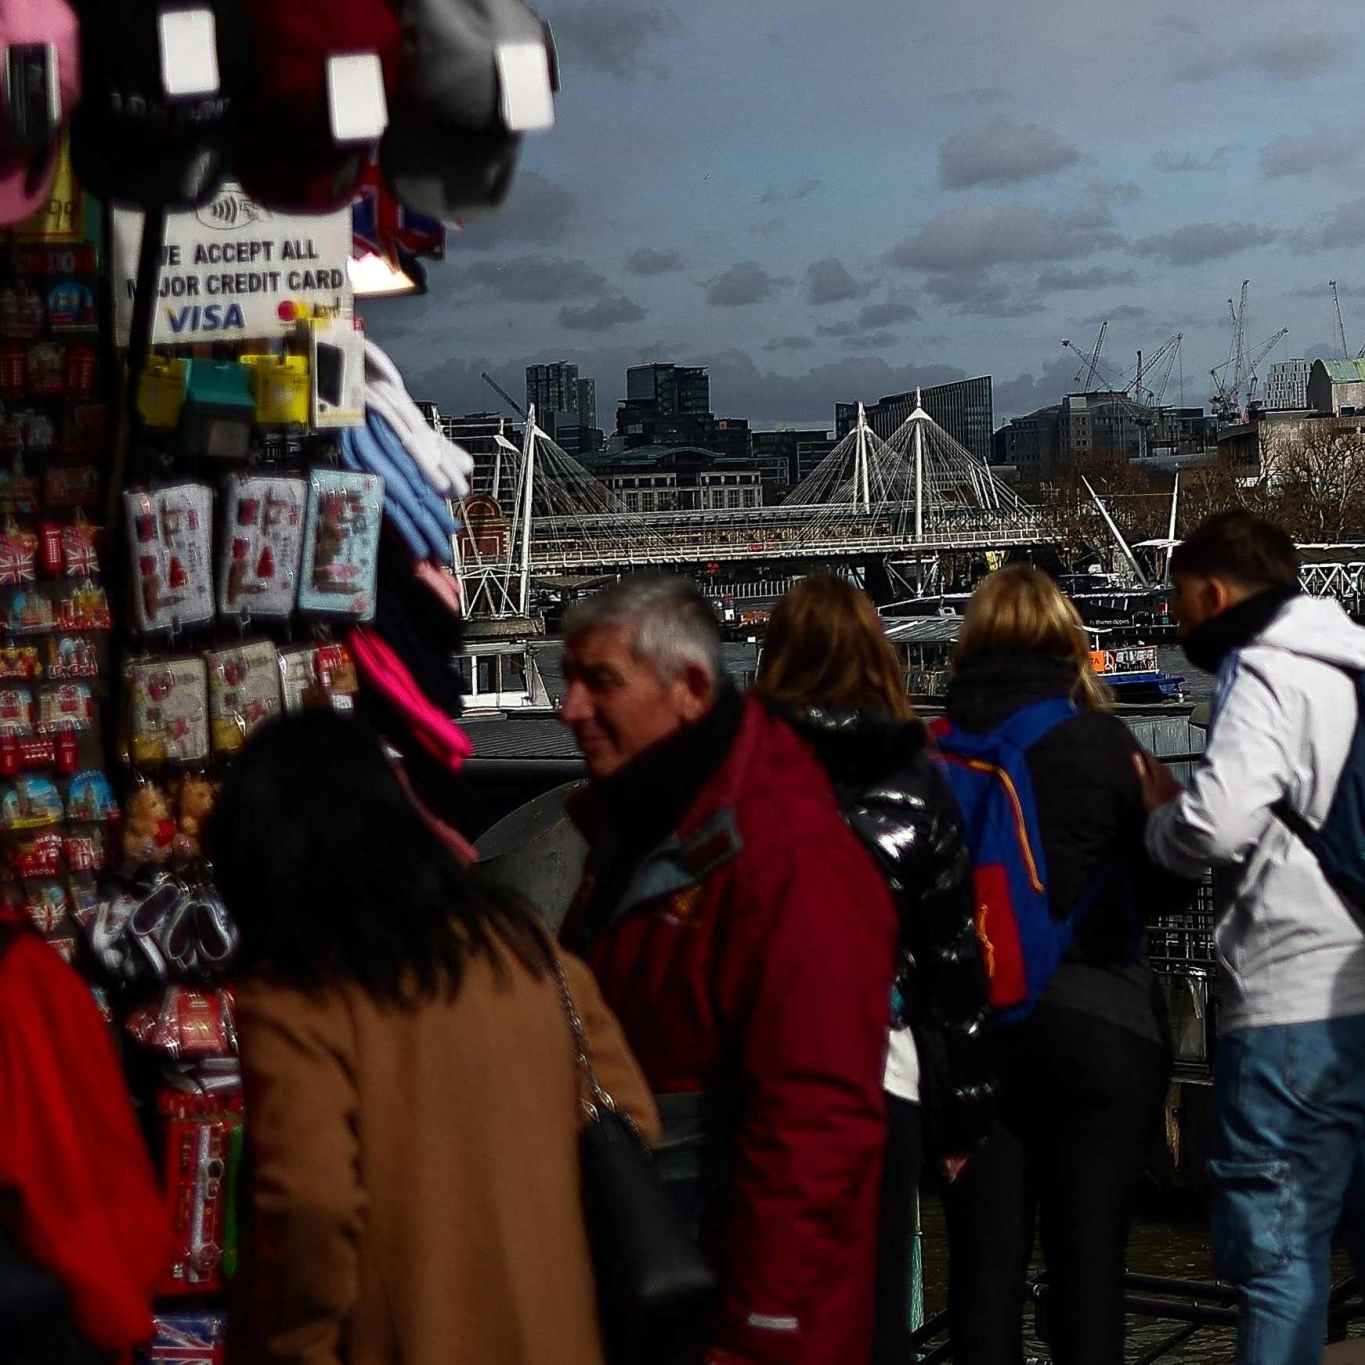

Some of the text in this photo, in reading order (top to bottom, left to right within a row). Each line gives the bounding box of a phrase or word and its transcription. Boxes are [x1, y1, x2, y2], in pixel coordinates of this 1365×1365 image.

[195, 241, 274, 265] ACCEPT
[282, 239, 319, 260] ALL
[127, 269, 344, 299] MJOR CREDIT CARD
[167, 304, 246, 333] VISA
